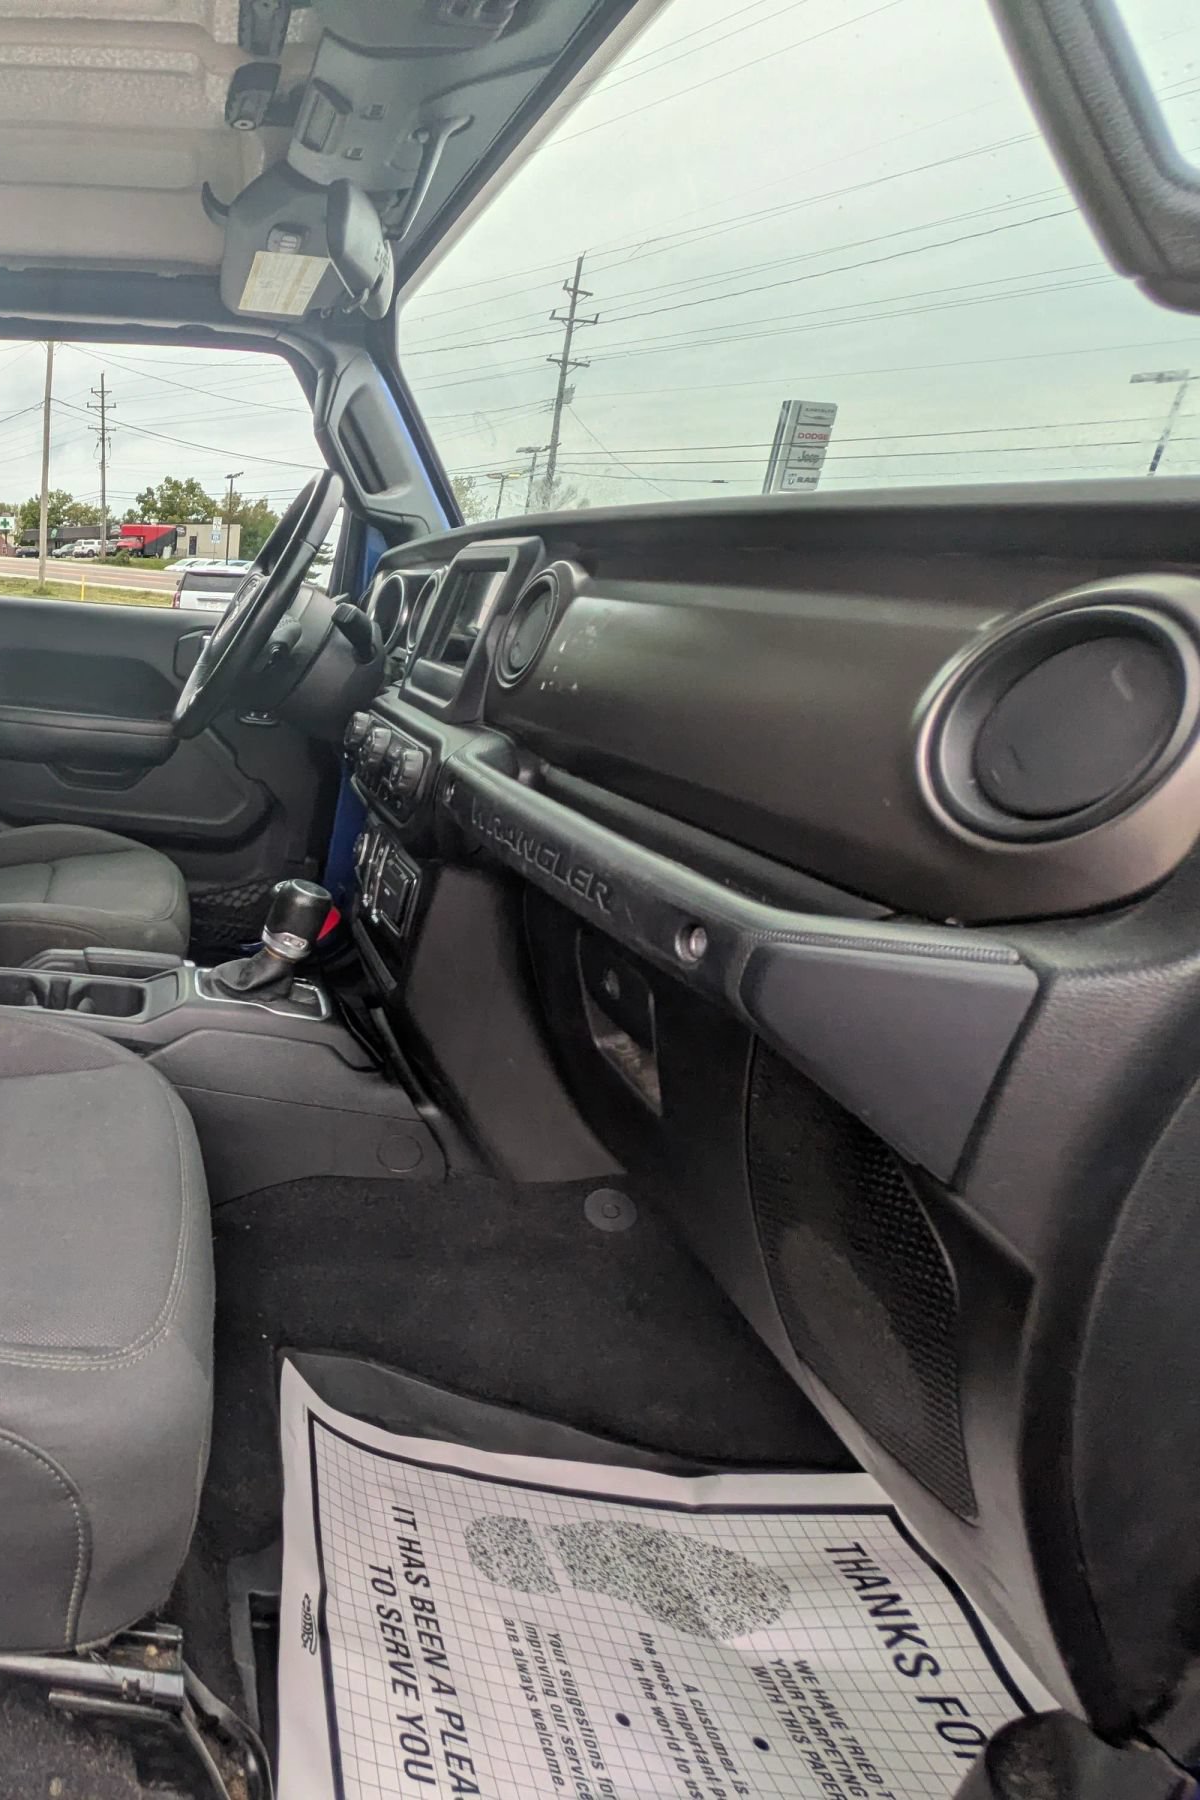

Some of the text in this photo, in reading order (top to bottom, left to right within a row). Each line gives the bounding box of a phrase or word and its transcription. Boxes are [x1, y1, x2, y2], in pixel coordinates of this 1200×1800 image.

[797, 432, 829, 440] DODGE
[797, 450, 820, 465] Jeep
[471, 794, 613, 913] WRANGLER
[369, 1563, 437, 1786] TO SERVE YOU
[391, 1505, 481, 1800] IT HAS BEEN A PLEA
[824, 1541, 941, 1678] THANKS
[503, 1617, 566, 1793] are always welcome.
[523, 1619, 594, 1800] improving our service
[547, 1632, 618, 1800] Your suggestions for
[629, 1657, 704, 1800] in the world to us
[638, 1631, 658, 1657] the
[650, 1659, 680, 1698] most
[670, 1702, 722, 1782] important
[681, 1682, 749, 1796] A customer is
[751, 1665, 849, 1800] WITH THIS PAPER
[769, 1657, 870, 1798] YOUR CARPETING
[793, 1659, 819, 1686] WE
[809, 1688, 850, 1731] HAVE
[839, 1734, 885, 1787] TRIED
